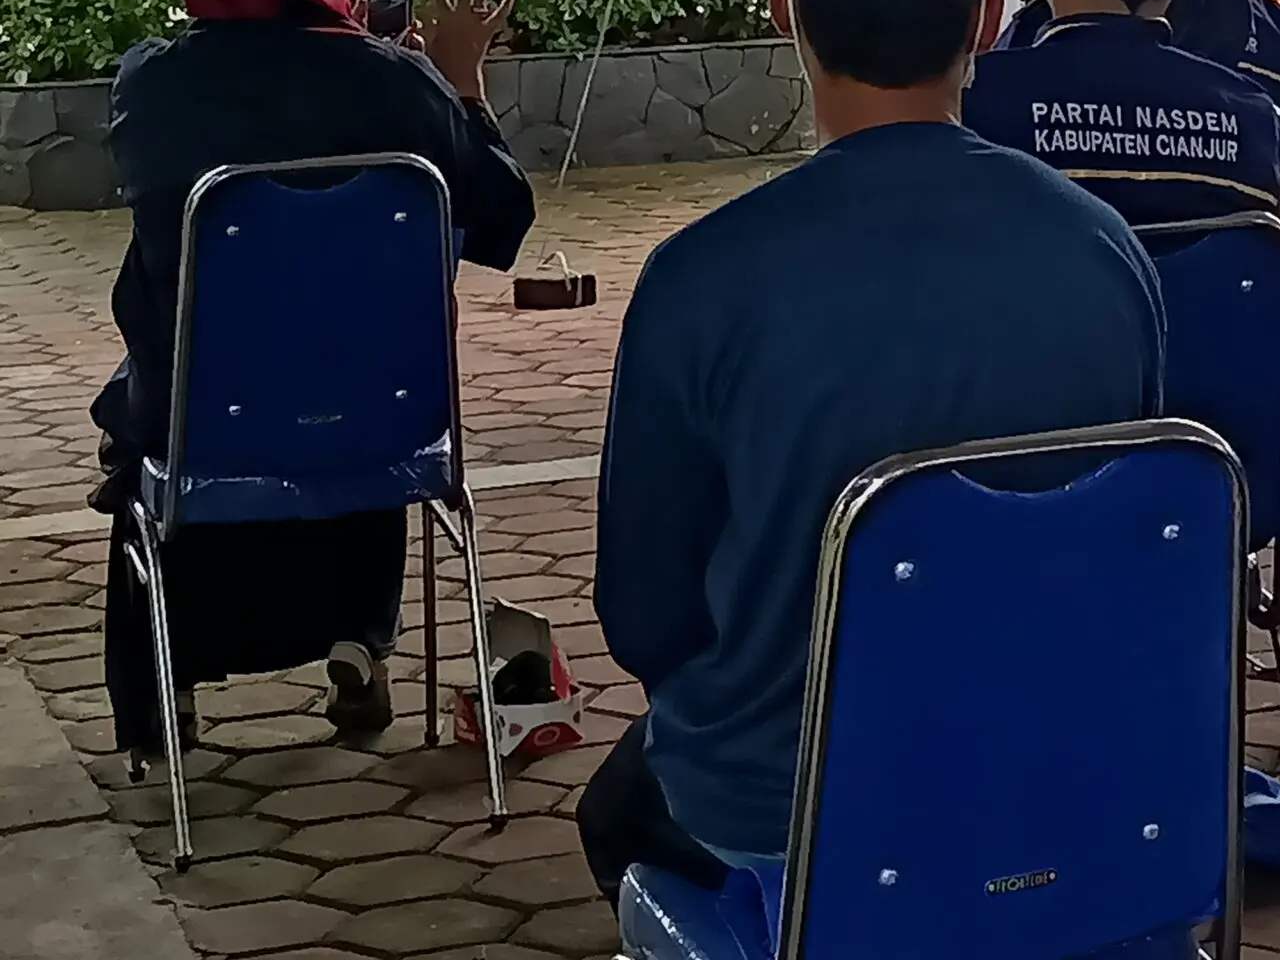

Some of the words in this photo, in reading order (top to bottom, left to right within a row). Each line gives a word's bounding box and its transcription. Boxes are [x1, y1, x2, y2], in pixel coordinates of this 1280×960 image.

[1031, 102, 1123, 127] PARTAI
[1135, 106, 1239, 136] NASDEM
[1034, 129, 1151, 156] KABUPATEN
[1156, 134, 1239, 162] CIANJUR
